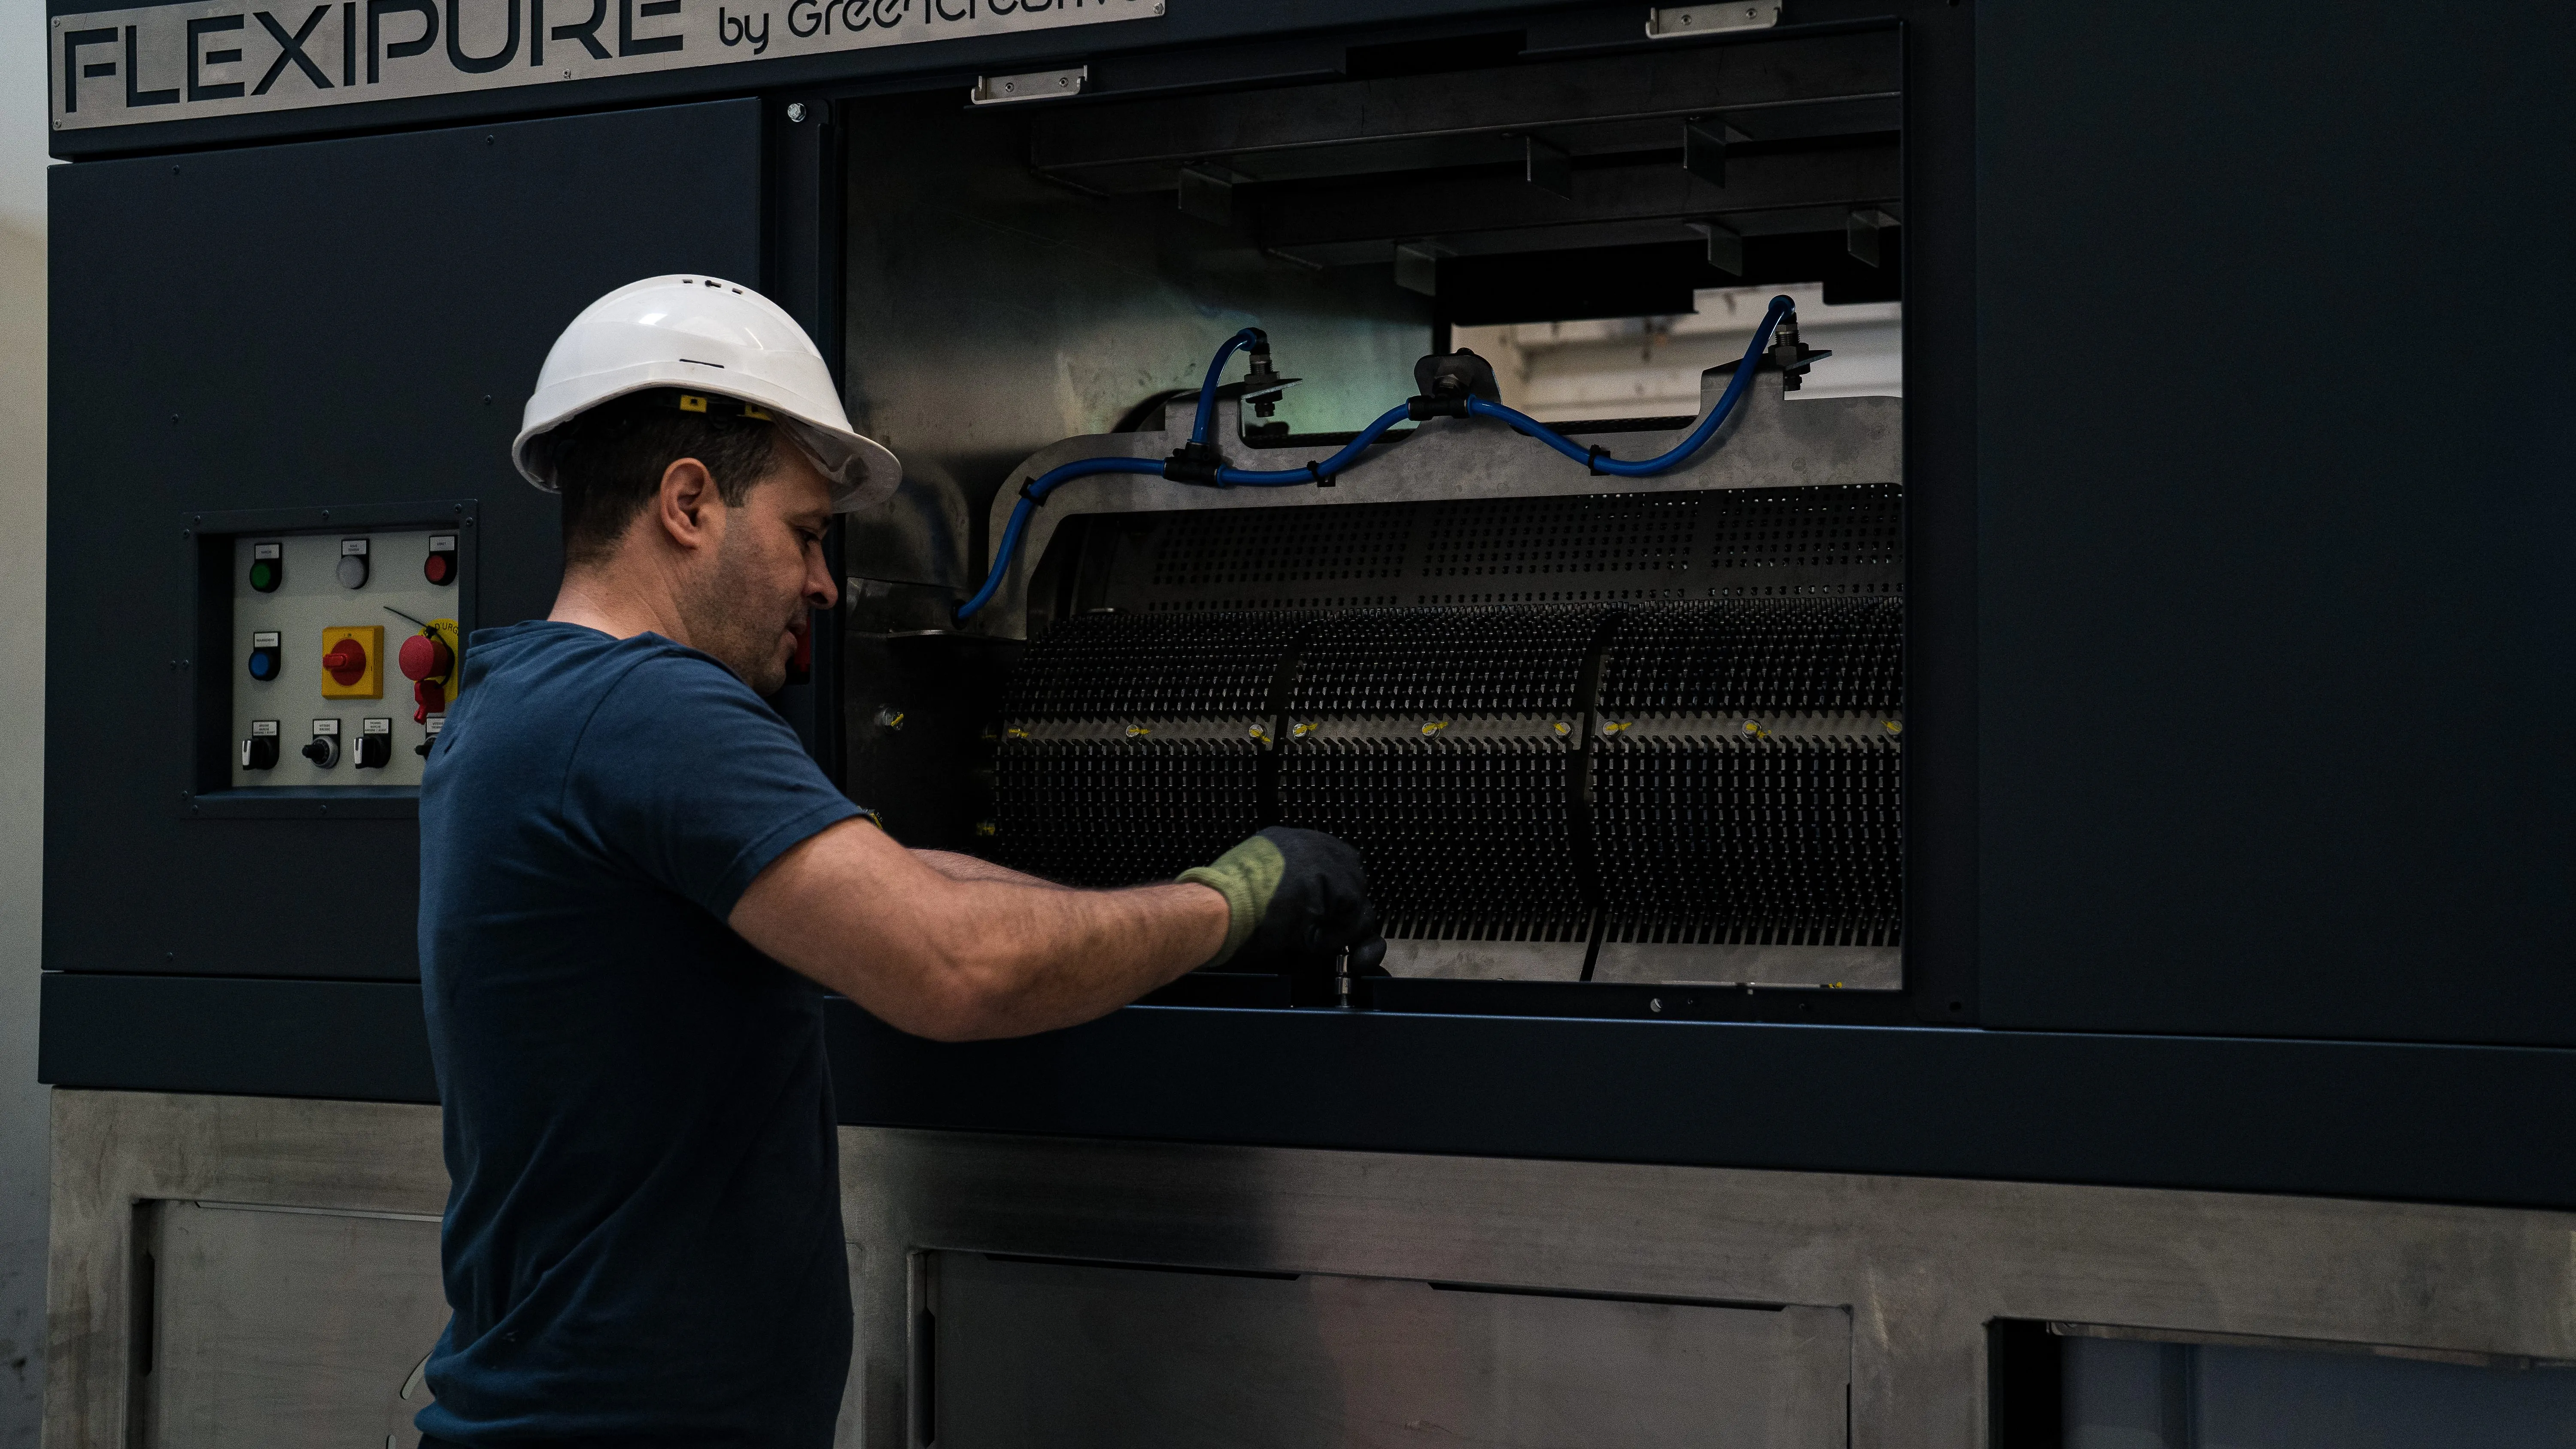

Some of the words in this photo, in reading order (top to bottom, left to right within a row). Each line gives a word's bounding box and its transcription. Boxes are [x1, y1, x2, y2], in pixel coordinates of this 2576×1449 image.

[64, 0, 683, 113] FLEXIPURE
[720, 7, 769, 55] by
[434, 622, 458, 636] D'URG
